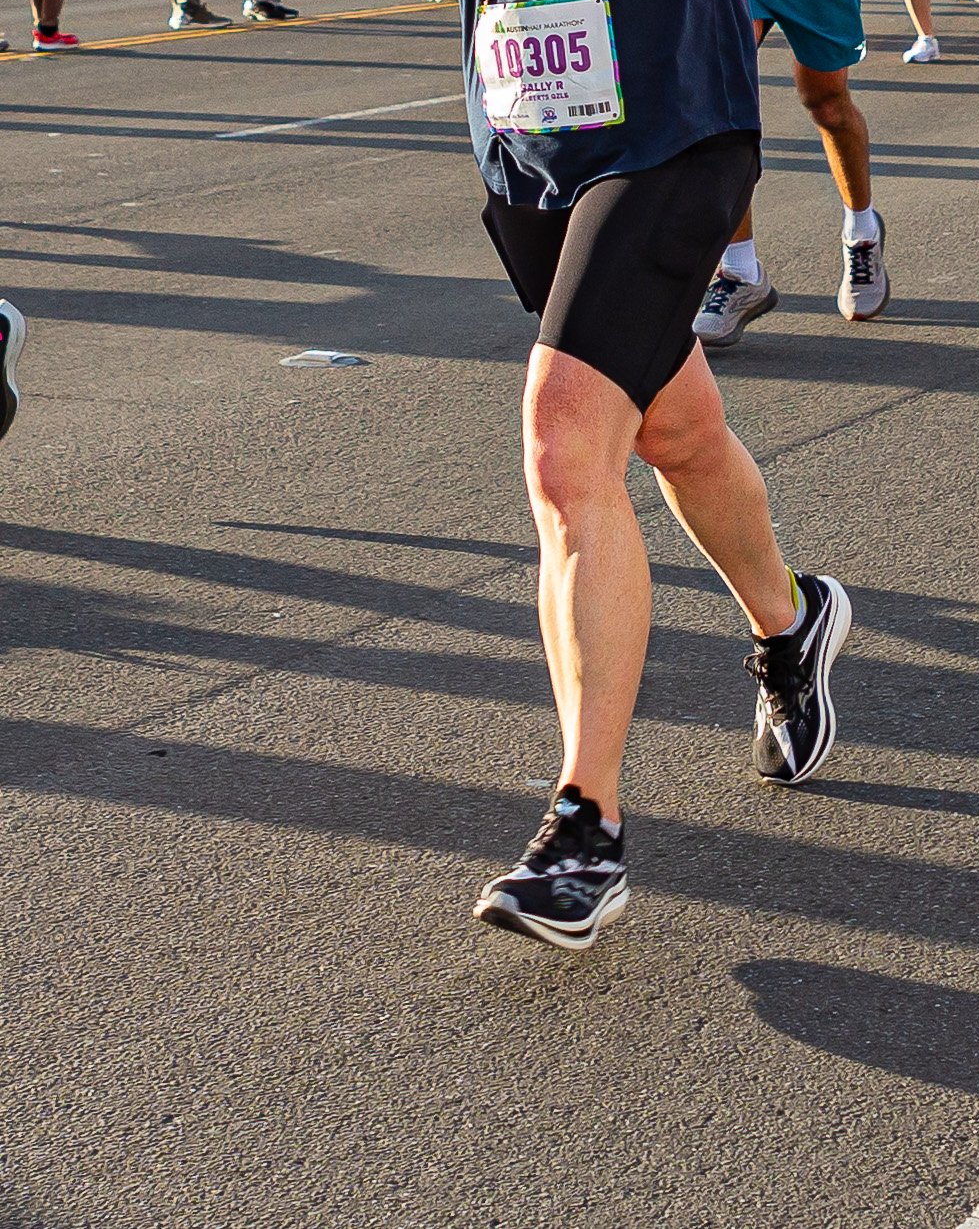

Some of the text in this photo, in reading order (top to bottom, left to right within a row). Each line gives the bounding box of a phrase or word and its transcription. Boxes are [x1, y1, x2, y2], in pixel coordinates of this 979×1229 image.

[490, 30, 592, 79] 10305
[521, 81, 564, 93] SALLY R
